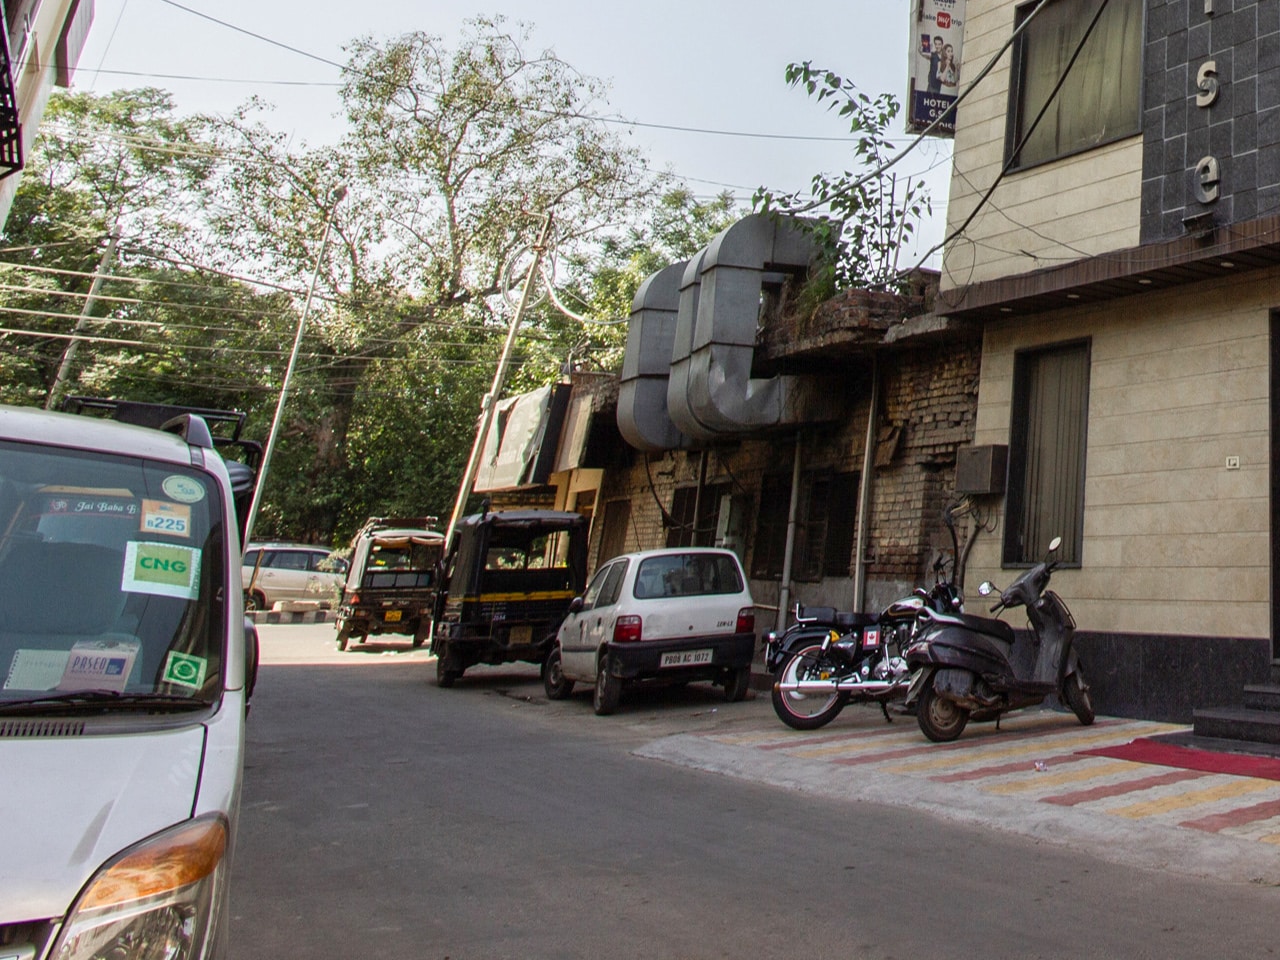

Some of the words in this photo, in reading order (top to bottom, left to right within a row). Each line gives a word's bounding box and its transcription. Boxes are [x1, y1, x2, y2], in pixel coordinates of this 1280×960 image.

[75, 501, 94, 512] Jai
[97, 501, 124, 513] Baba
[140, 557, 187, 574] CNG
[72, 656, 107, 670] PASEO
